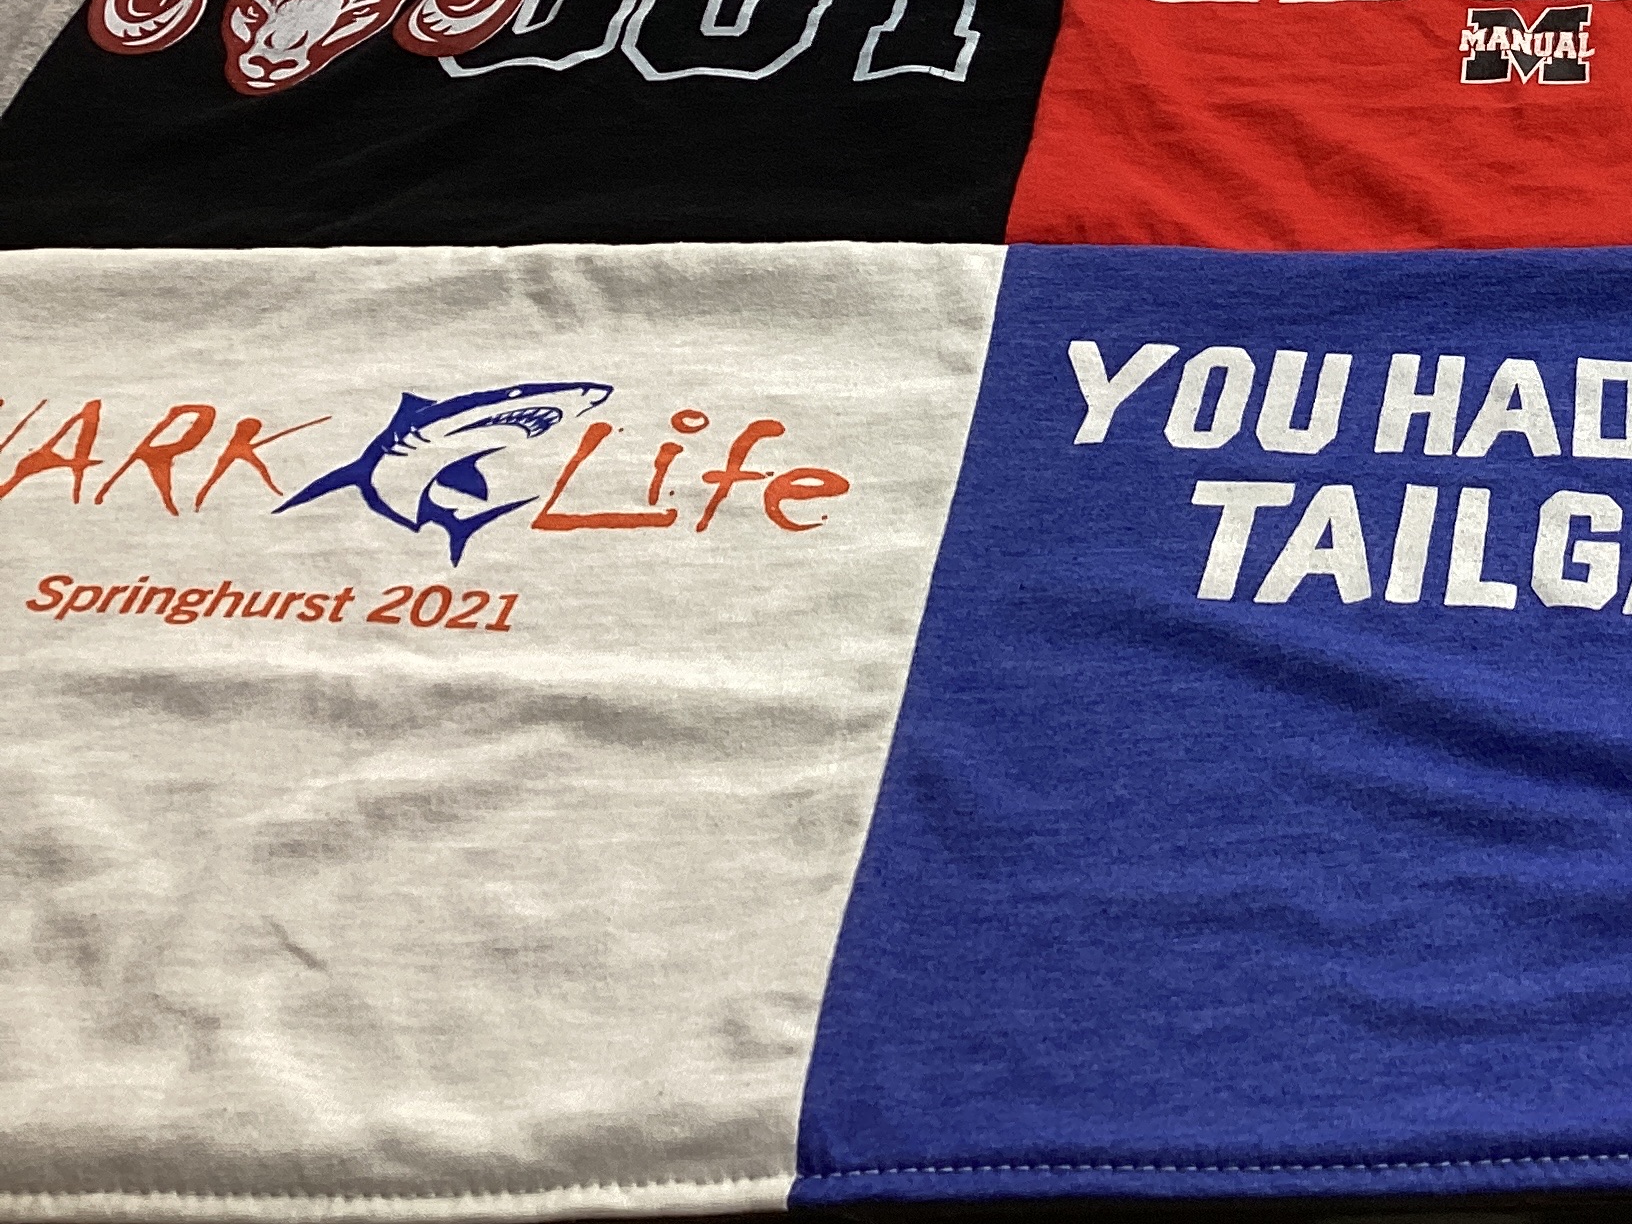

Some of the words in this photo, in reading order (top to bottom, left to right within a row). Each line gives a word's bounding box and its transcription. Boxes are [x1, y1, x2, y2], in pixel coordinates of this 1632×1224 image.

[1459, 26, 1596, 60] MANUAL
[1069, 340, 1352, 456] YOU
[0, 399, 332, 517] ARK
[529, 409, 851, 534] Life
[25, 574, 354, 627] Springhurst
[366, 583, 521, 633] 2021
